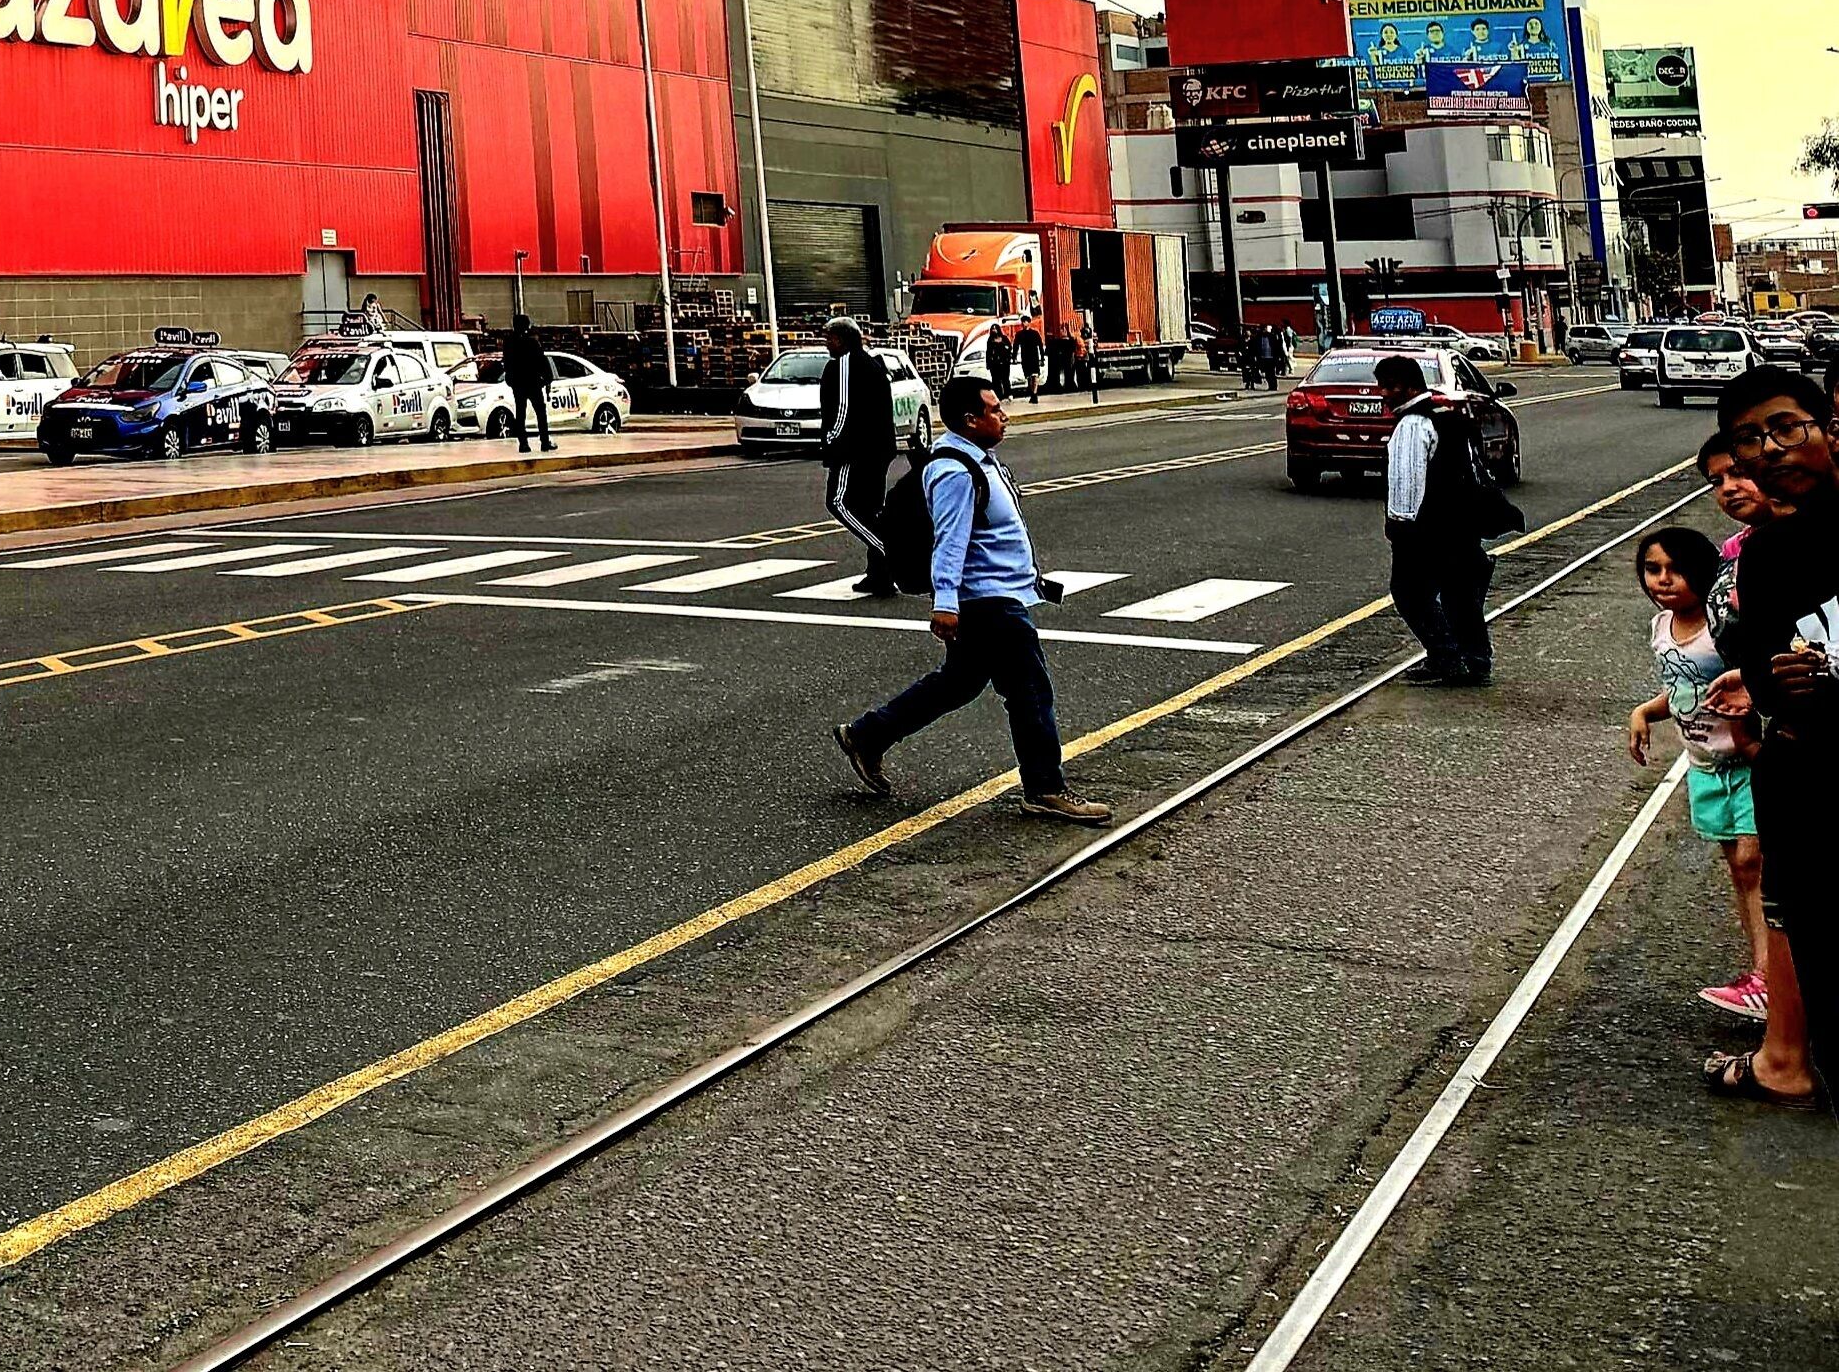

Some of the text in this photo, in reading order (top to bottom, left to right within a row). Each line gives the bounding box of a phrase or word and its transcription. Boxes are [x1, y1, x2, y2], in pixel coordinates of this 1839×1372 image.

[1357, 2, 1380, 15] EN
[1204, 85, 1247, 100] KFC
[1282, 82, 1347, 98] Pizza Hut
[153, 61, 244, 144] hiper
[1247, 131, 1348, 152] cineplanet
